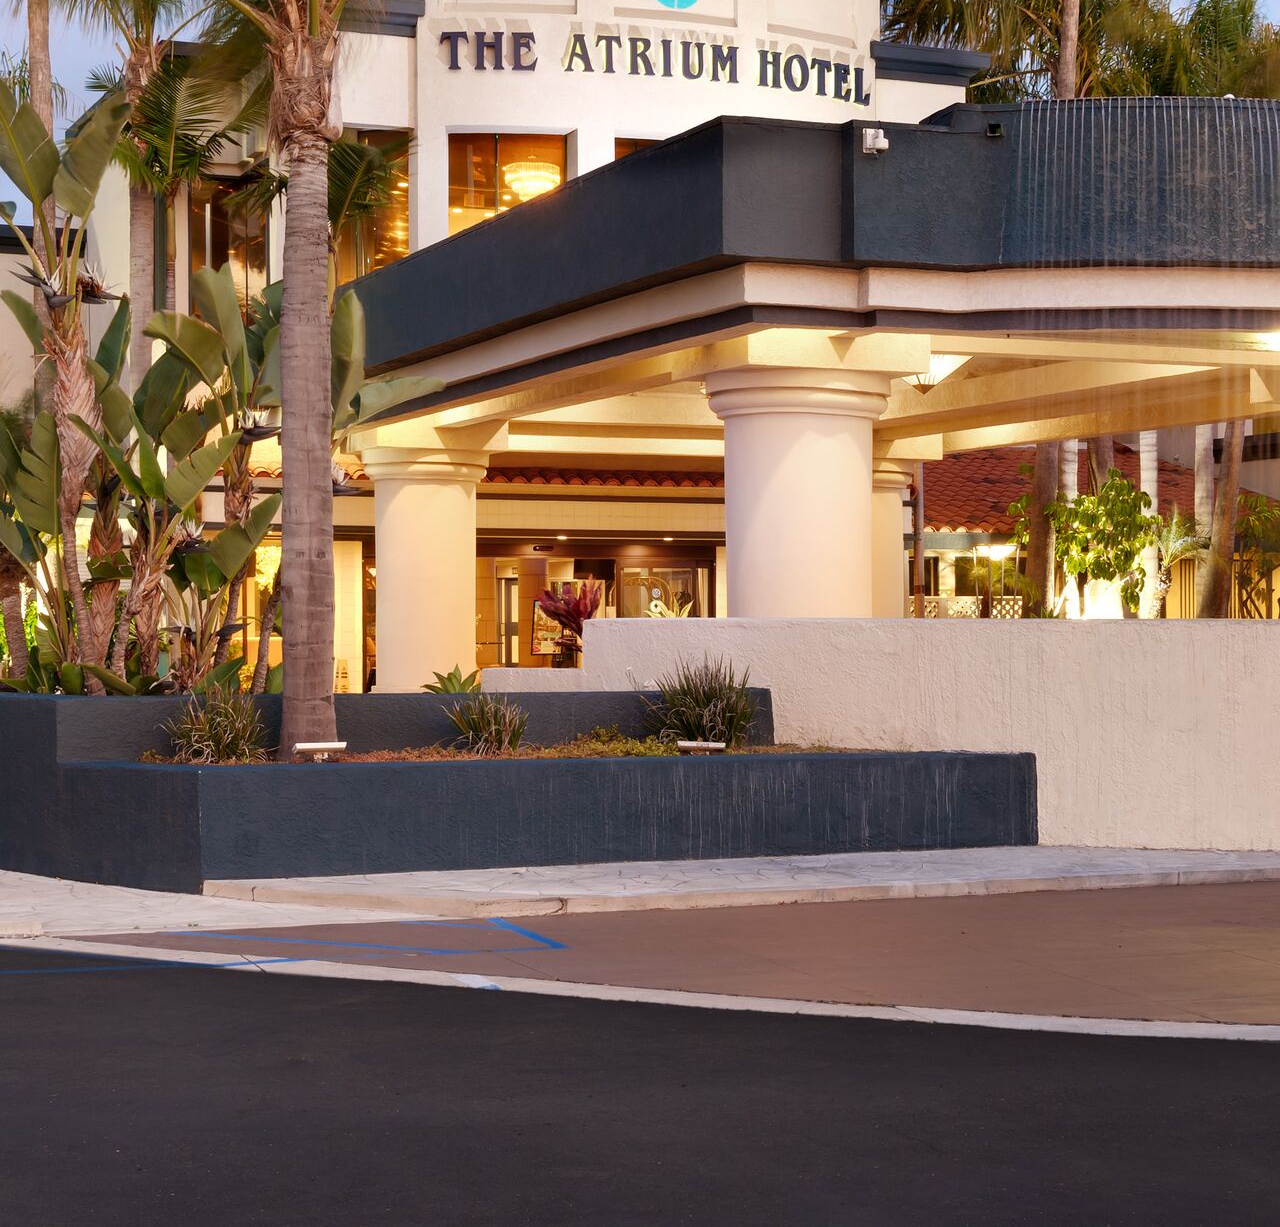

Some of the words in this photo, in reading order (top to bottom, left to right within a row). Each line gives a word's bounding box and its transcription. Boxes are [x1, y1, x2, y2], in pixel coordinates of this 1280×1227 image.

[440, 31, 538, 71] THE
[564, 33, 739, 84] ATRIUM
[758, 49, 871, 106] HOTEL
